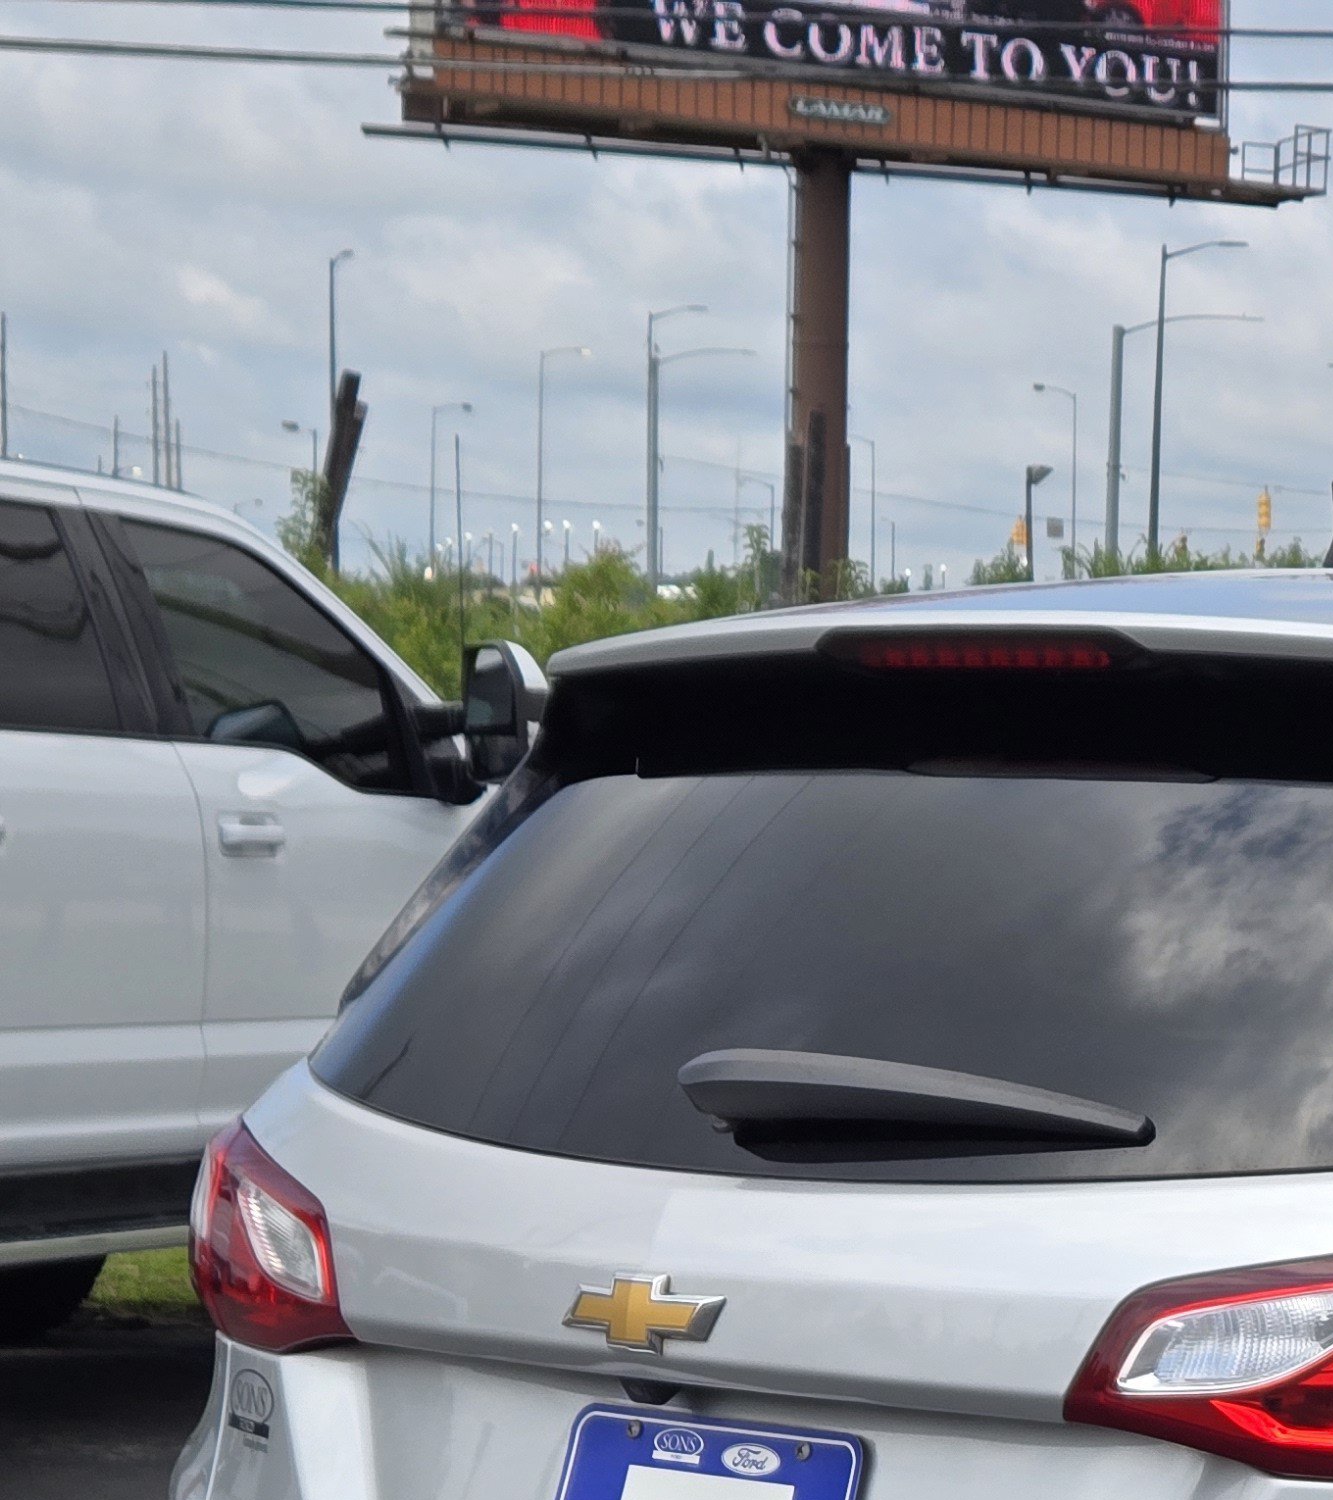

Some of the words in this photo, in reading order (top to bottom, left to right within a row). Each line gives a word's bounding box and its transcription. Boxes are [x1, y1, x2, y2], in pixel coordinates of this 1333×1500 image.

[654, 0, 747, 51] WE
[762, 7, 944, 73] COME
[961, 30, 1045, 81] TO
[1060, 42, 1199, 106] YOU!
[659, 1433, 698, 1453] SONS
[732, 1447, 769, 1471] Ford
